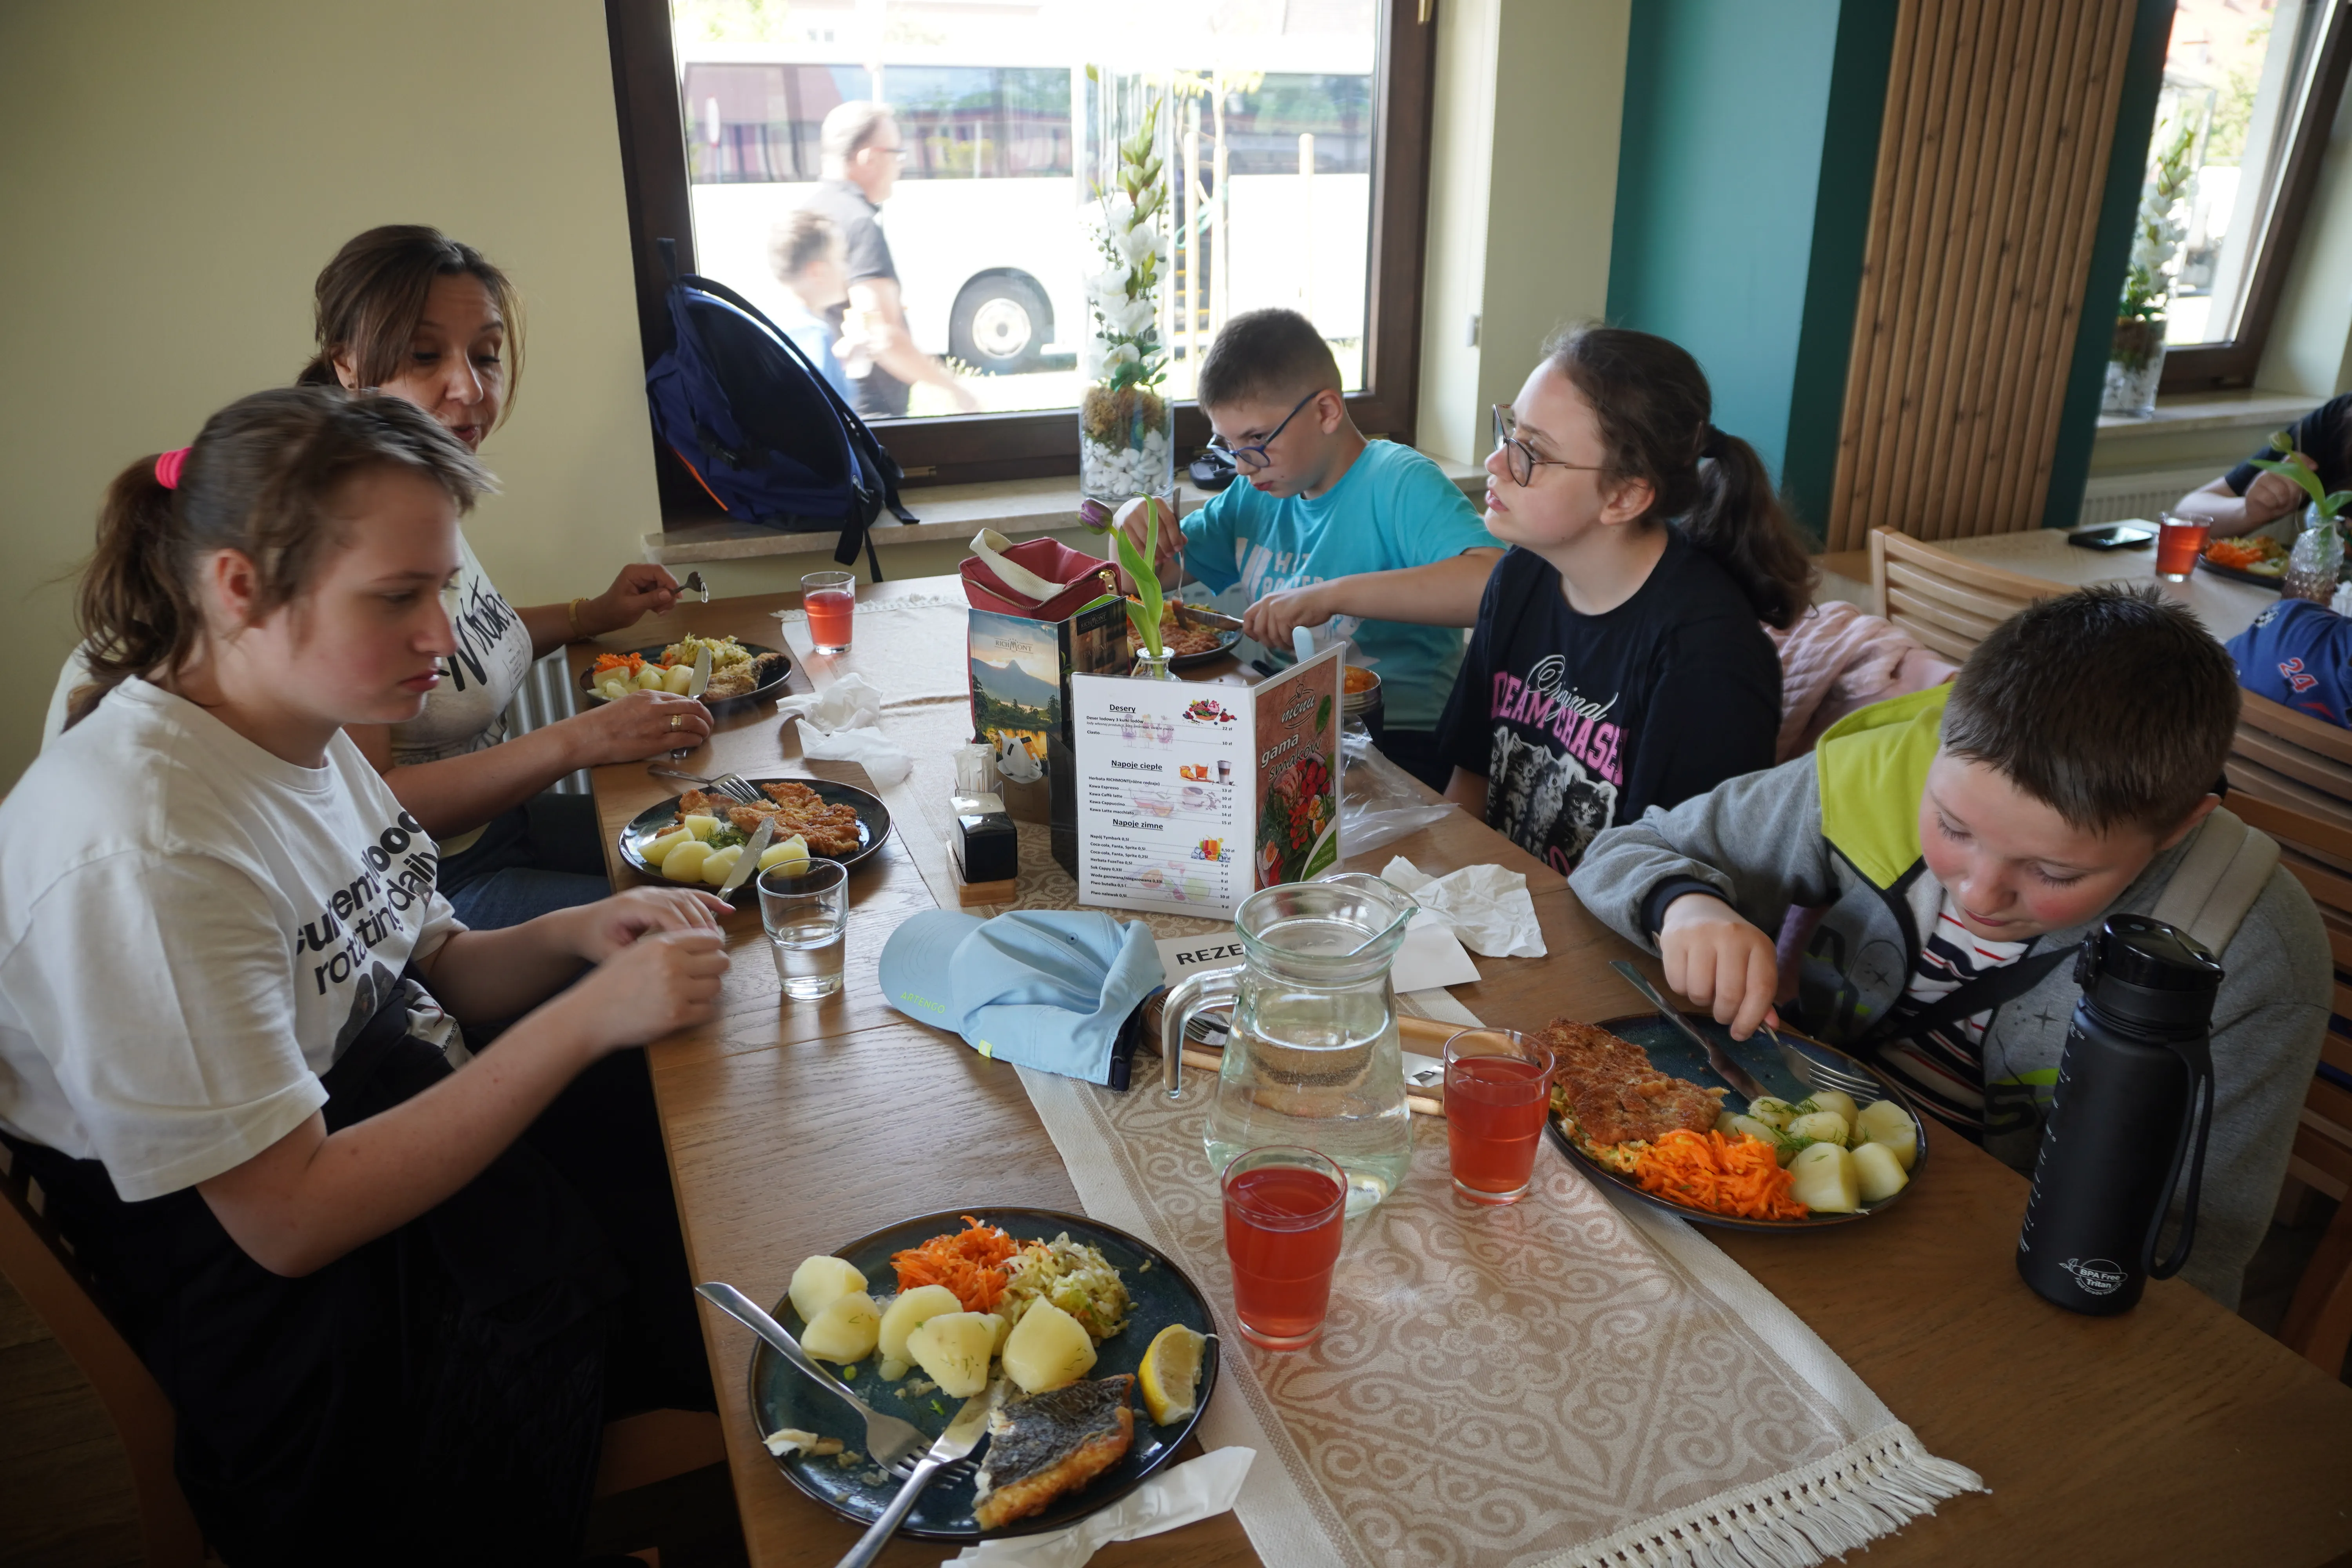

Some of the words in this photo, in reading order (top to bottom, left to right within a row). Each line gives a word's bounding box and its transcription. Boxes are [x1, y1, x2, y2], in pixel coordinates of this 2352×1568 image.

[995, 639, 1032, 652] RICHMONT
[1081, 652, 1092, 660] TEA
[1092, 642, 1109, 654] MENU
[2278, 657, 2318, 693] 24
[1526, 654, 1618, 721] Original
[1109, 704, 1136, 713] Desery
[1281, 694, 1316, 723] menu
[1261, 733, 1299, 769] gama
[1269, 738, 1322, 781] smaków
[1111, 760, 1138, 769] Napoje
[1140, 763, 1163, 771] ciepłe
[1112, 818, 1139, 828] Napoje
[1311, 851, 1334, 870] smacznego
[1103, 875, 1152, 883] gazowana/niegazowana
[900, 991, 946, 1014] ARTENGO
[2080, 1269, 2100, 1279] BPA
[2085, 1278, 2112, 1288] Tritan
